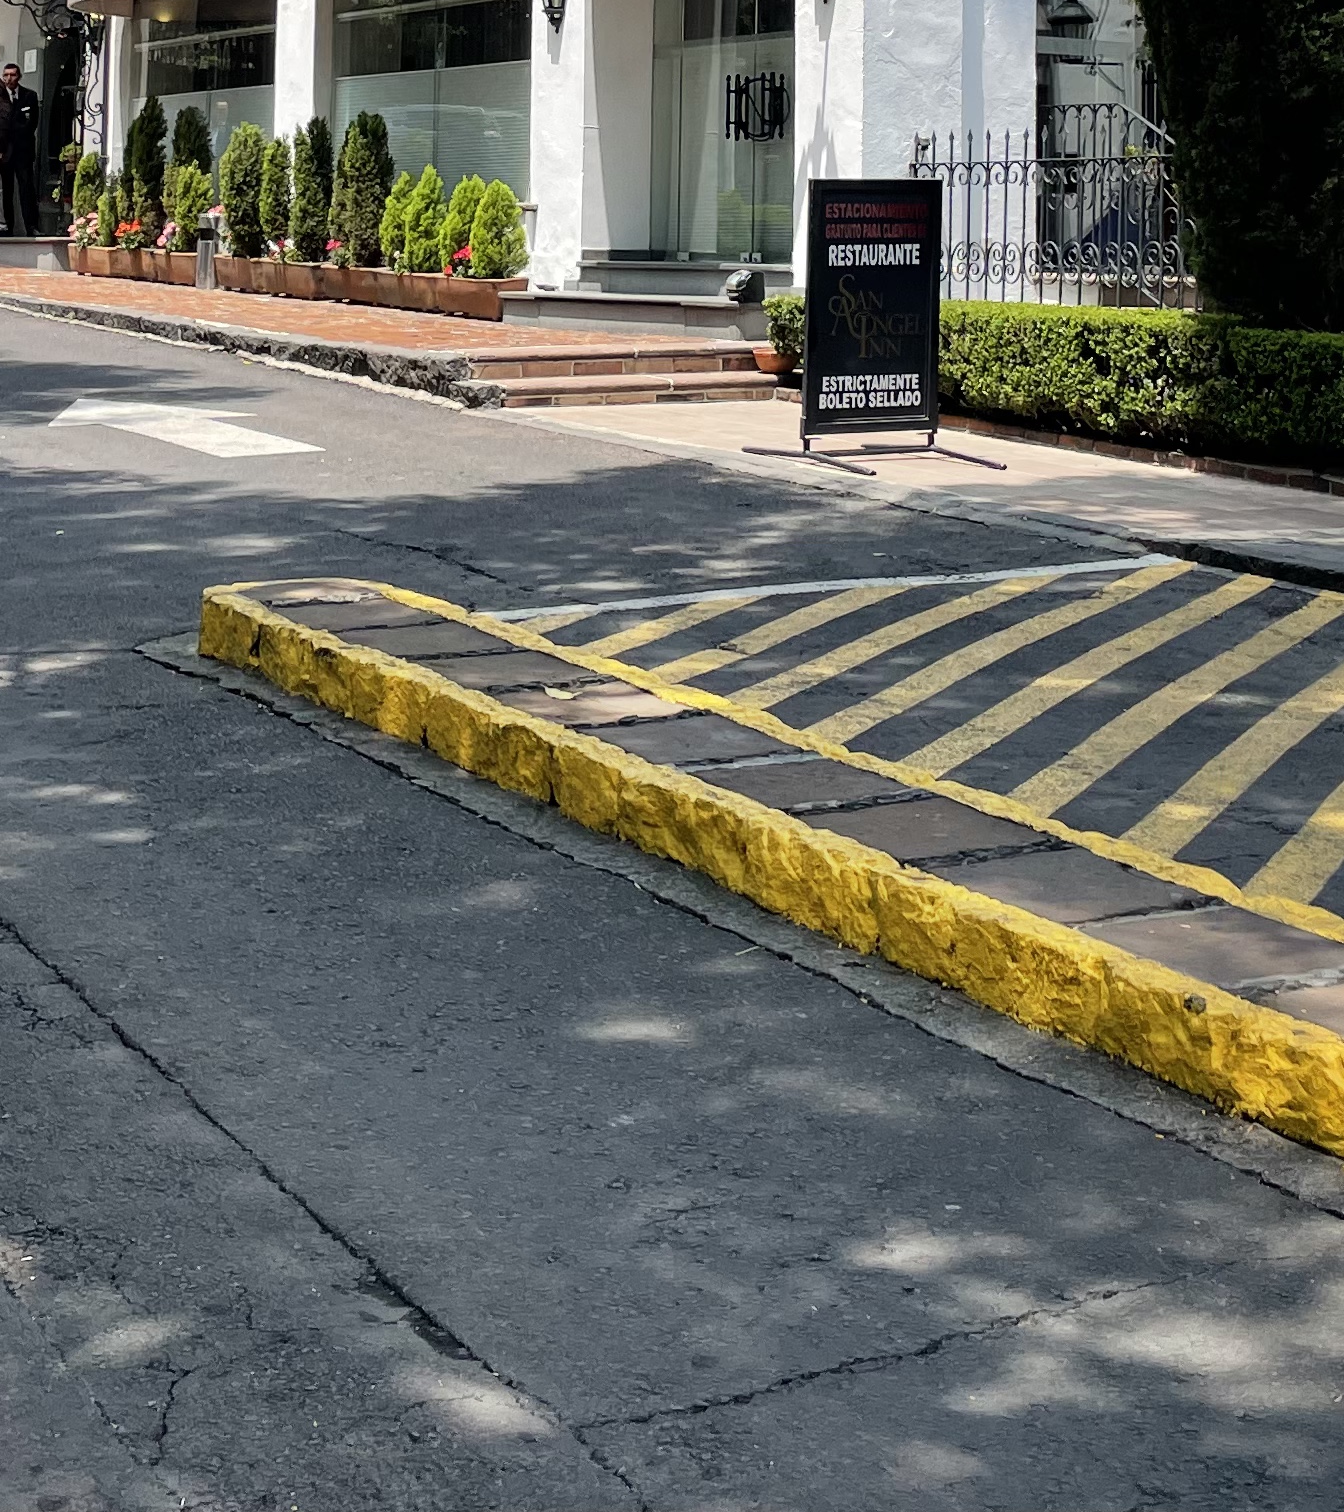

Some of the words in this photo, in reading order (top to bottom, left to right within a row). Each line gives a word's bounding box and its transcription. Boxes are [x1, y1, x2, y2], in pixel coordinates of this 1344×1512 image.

[863, 223, 882, 238] PARA
[828, 243, 921, 266] RESTAURANTE
[839, 274, 884, 312] SAN
[858, 314, 902, 358] INN
[822, 374, 920, 392] ESTRICTAMENTE
[818, 392, 866, 409] BOLETO
[868, 391, 922, 408] SELLADO
